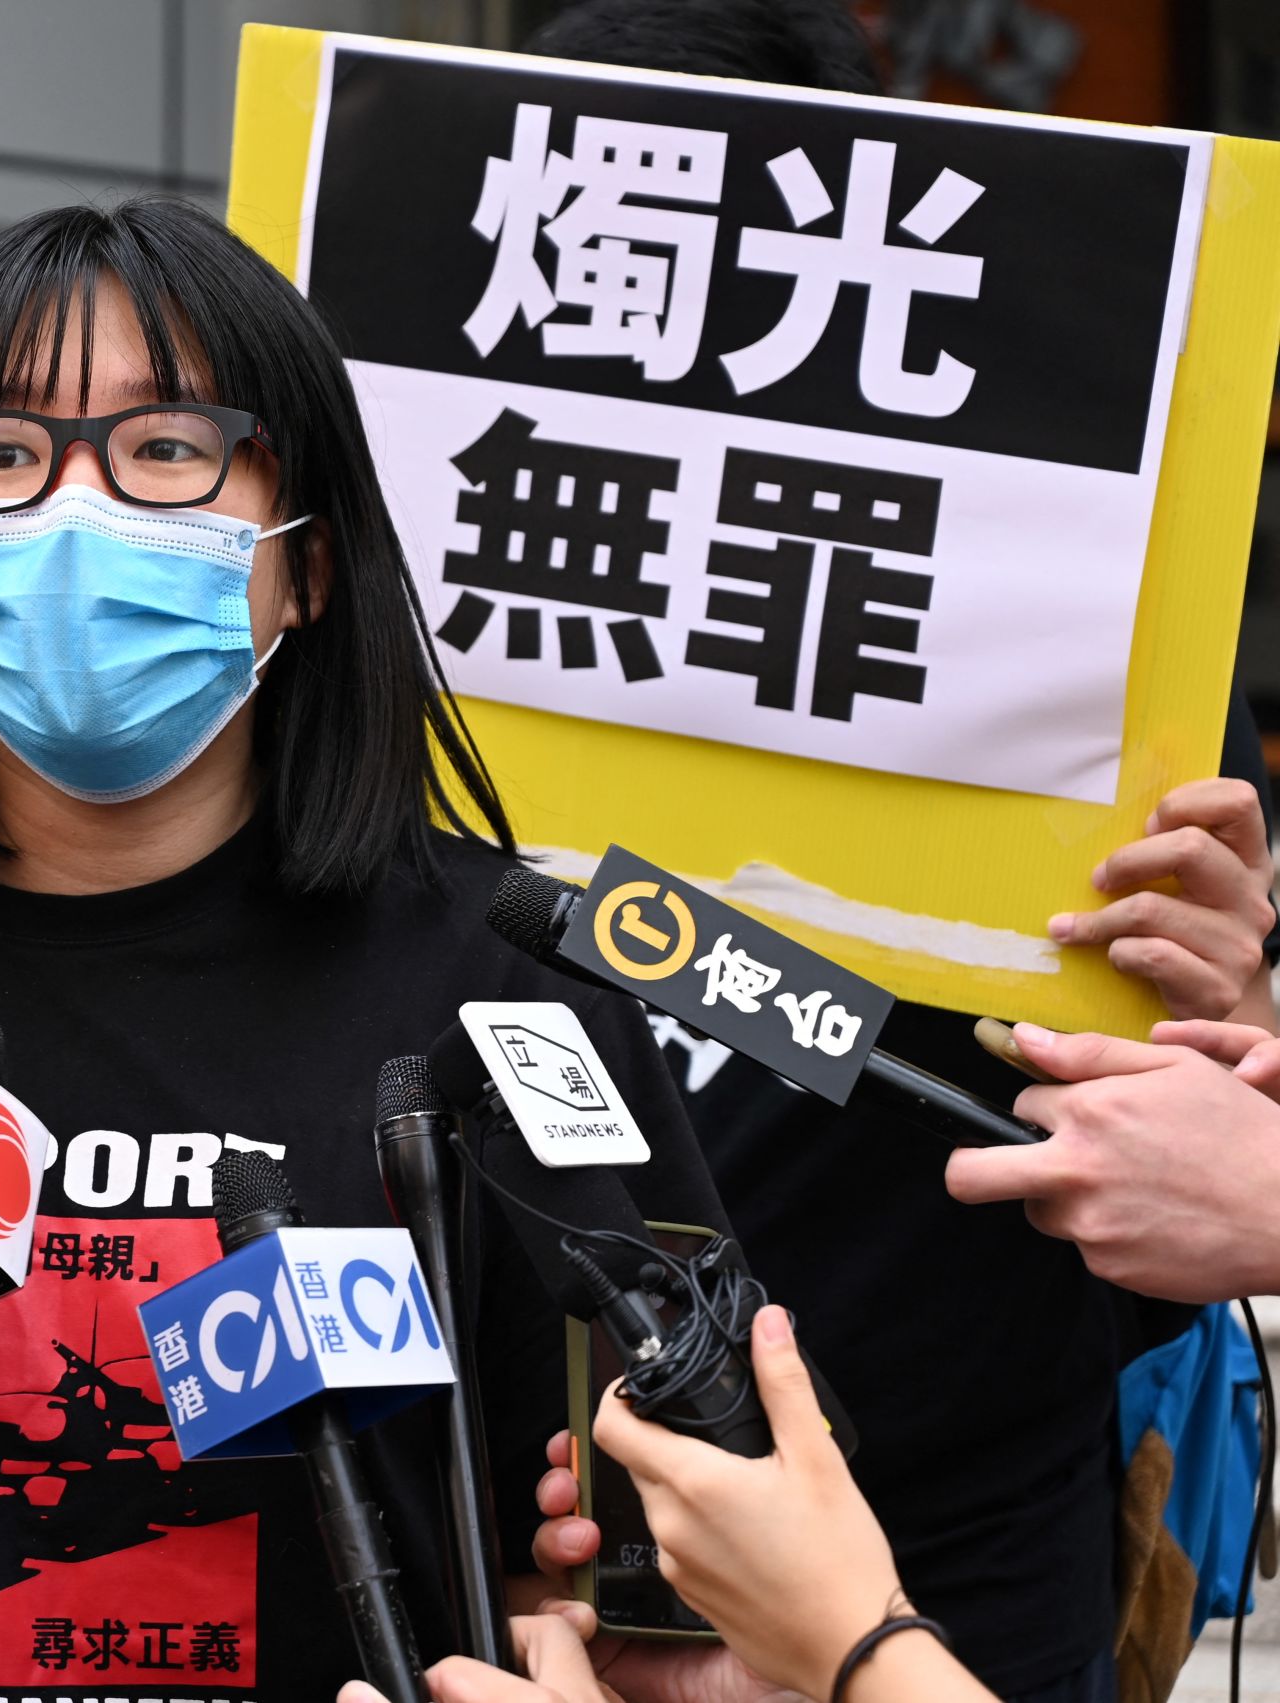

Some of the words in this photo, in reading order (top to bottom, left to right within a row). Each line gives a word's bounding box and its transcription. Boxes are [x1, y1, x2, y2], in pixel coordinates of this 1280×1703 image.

[461, 102, 987, 418] 燭光
[433, 405, 943, 723] 無罪
[693, 933, 862, 1057] 商台
[44, 1129, 287, 1208] OR
[544, 1123, 624, 1138] STANDNEWS
[26, 1232, 159, 1283] 母親」
[294, 1261, 348, 1355] 香港
[152, 1320, 208, 1426] 香港
[31, 1617, 241, 1673] 尋求正義
